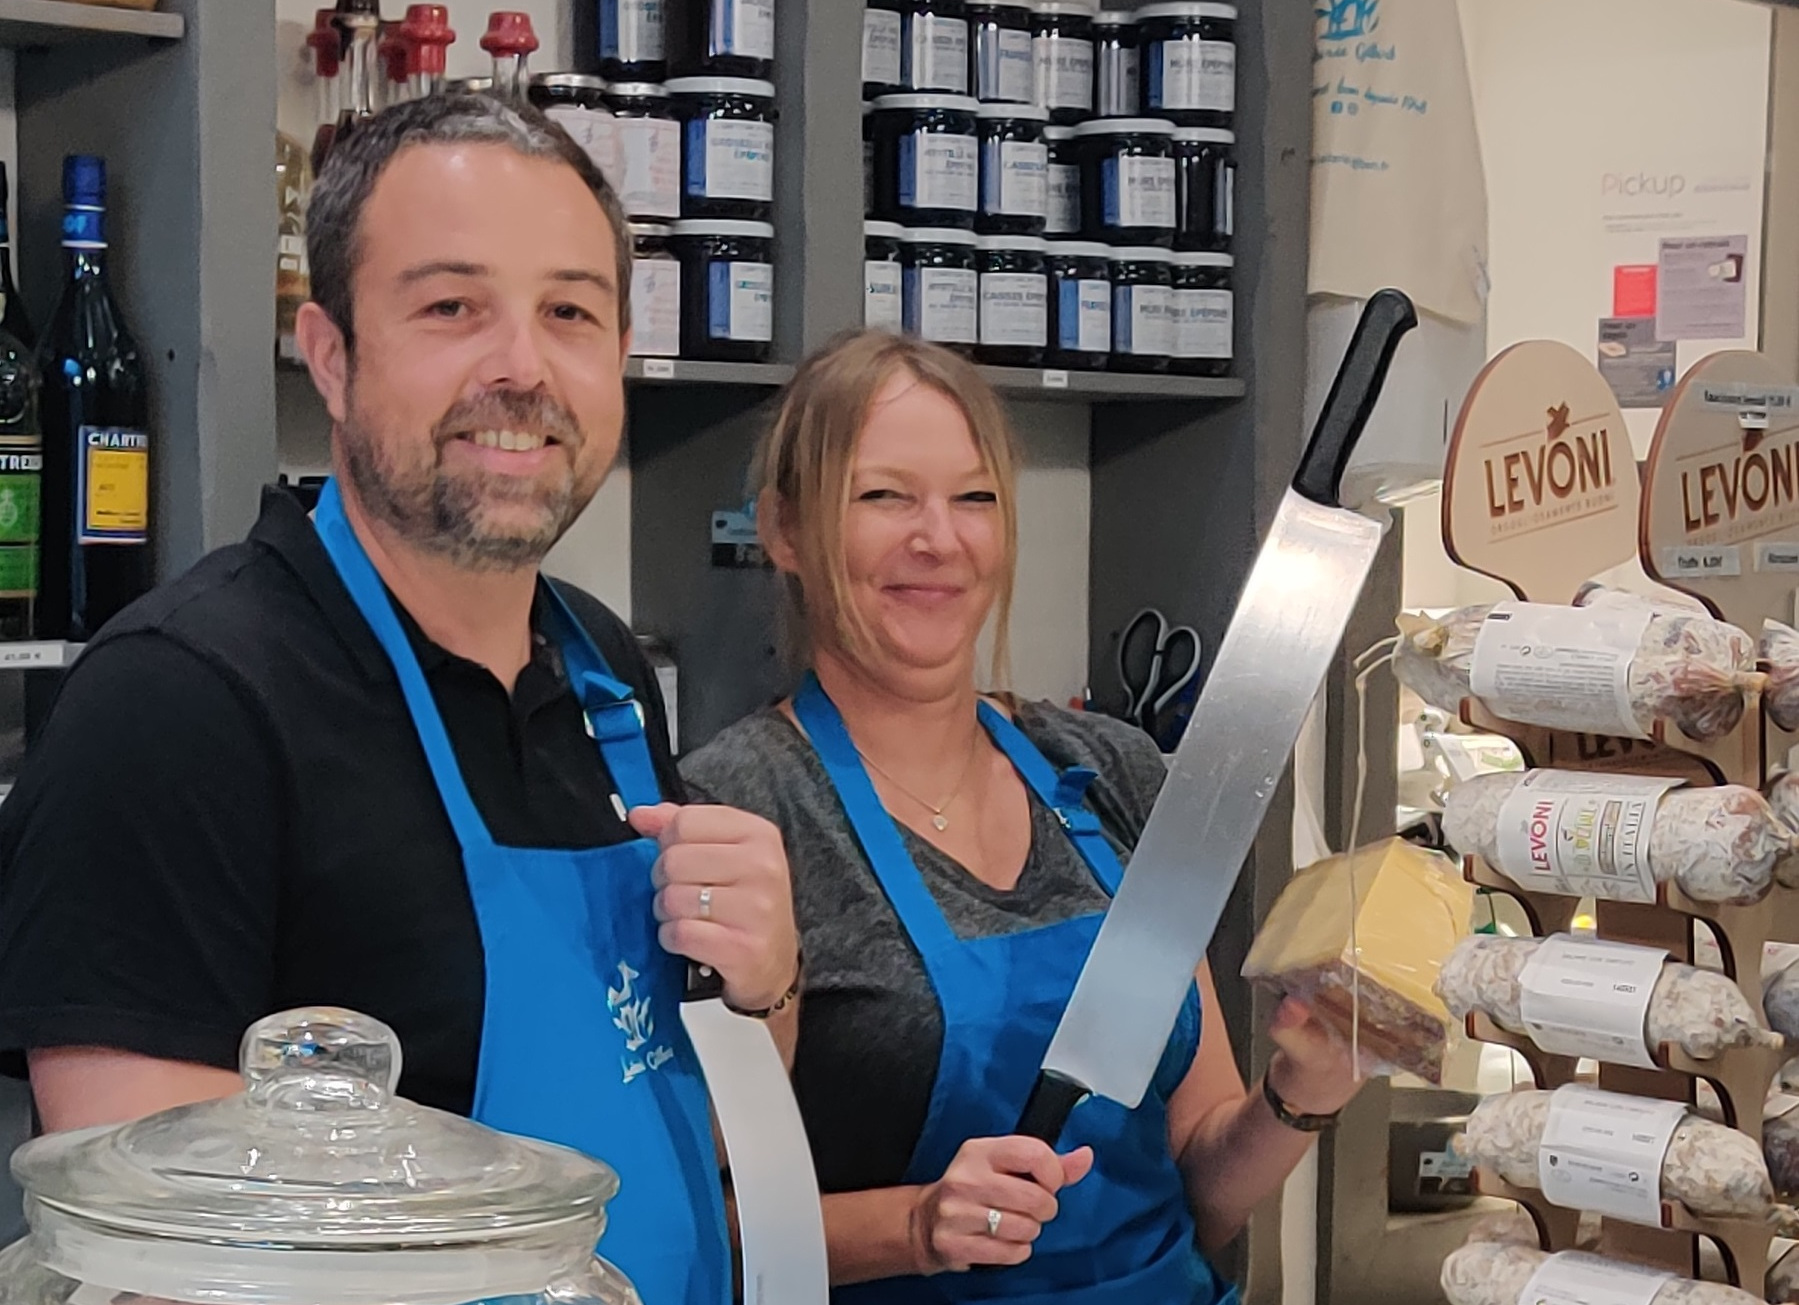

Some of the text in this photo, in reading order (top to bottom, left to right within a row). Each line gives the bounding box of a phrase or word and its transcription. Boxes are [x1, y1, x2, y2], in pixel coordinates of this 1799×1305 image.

[1602, 172, 1686, 198] Pickup
[1484, 428, 1613, 518] LEVONI
[1529, 800, 1556, 872] LEVONI
